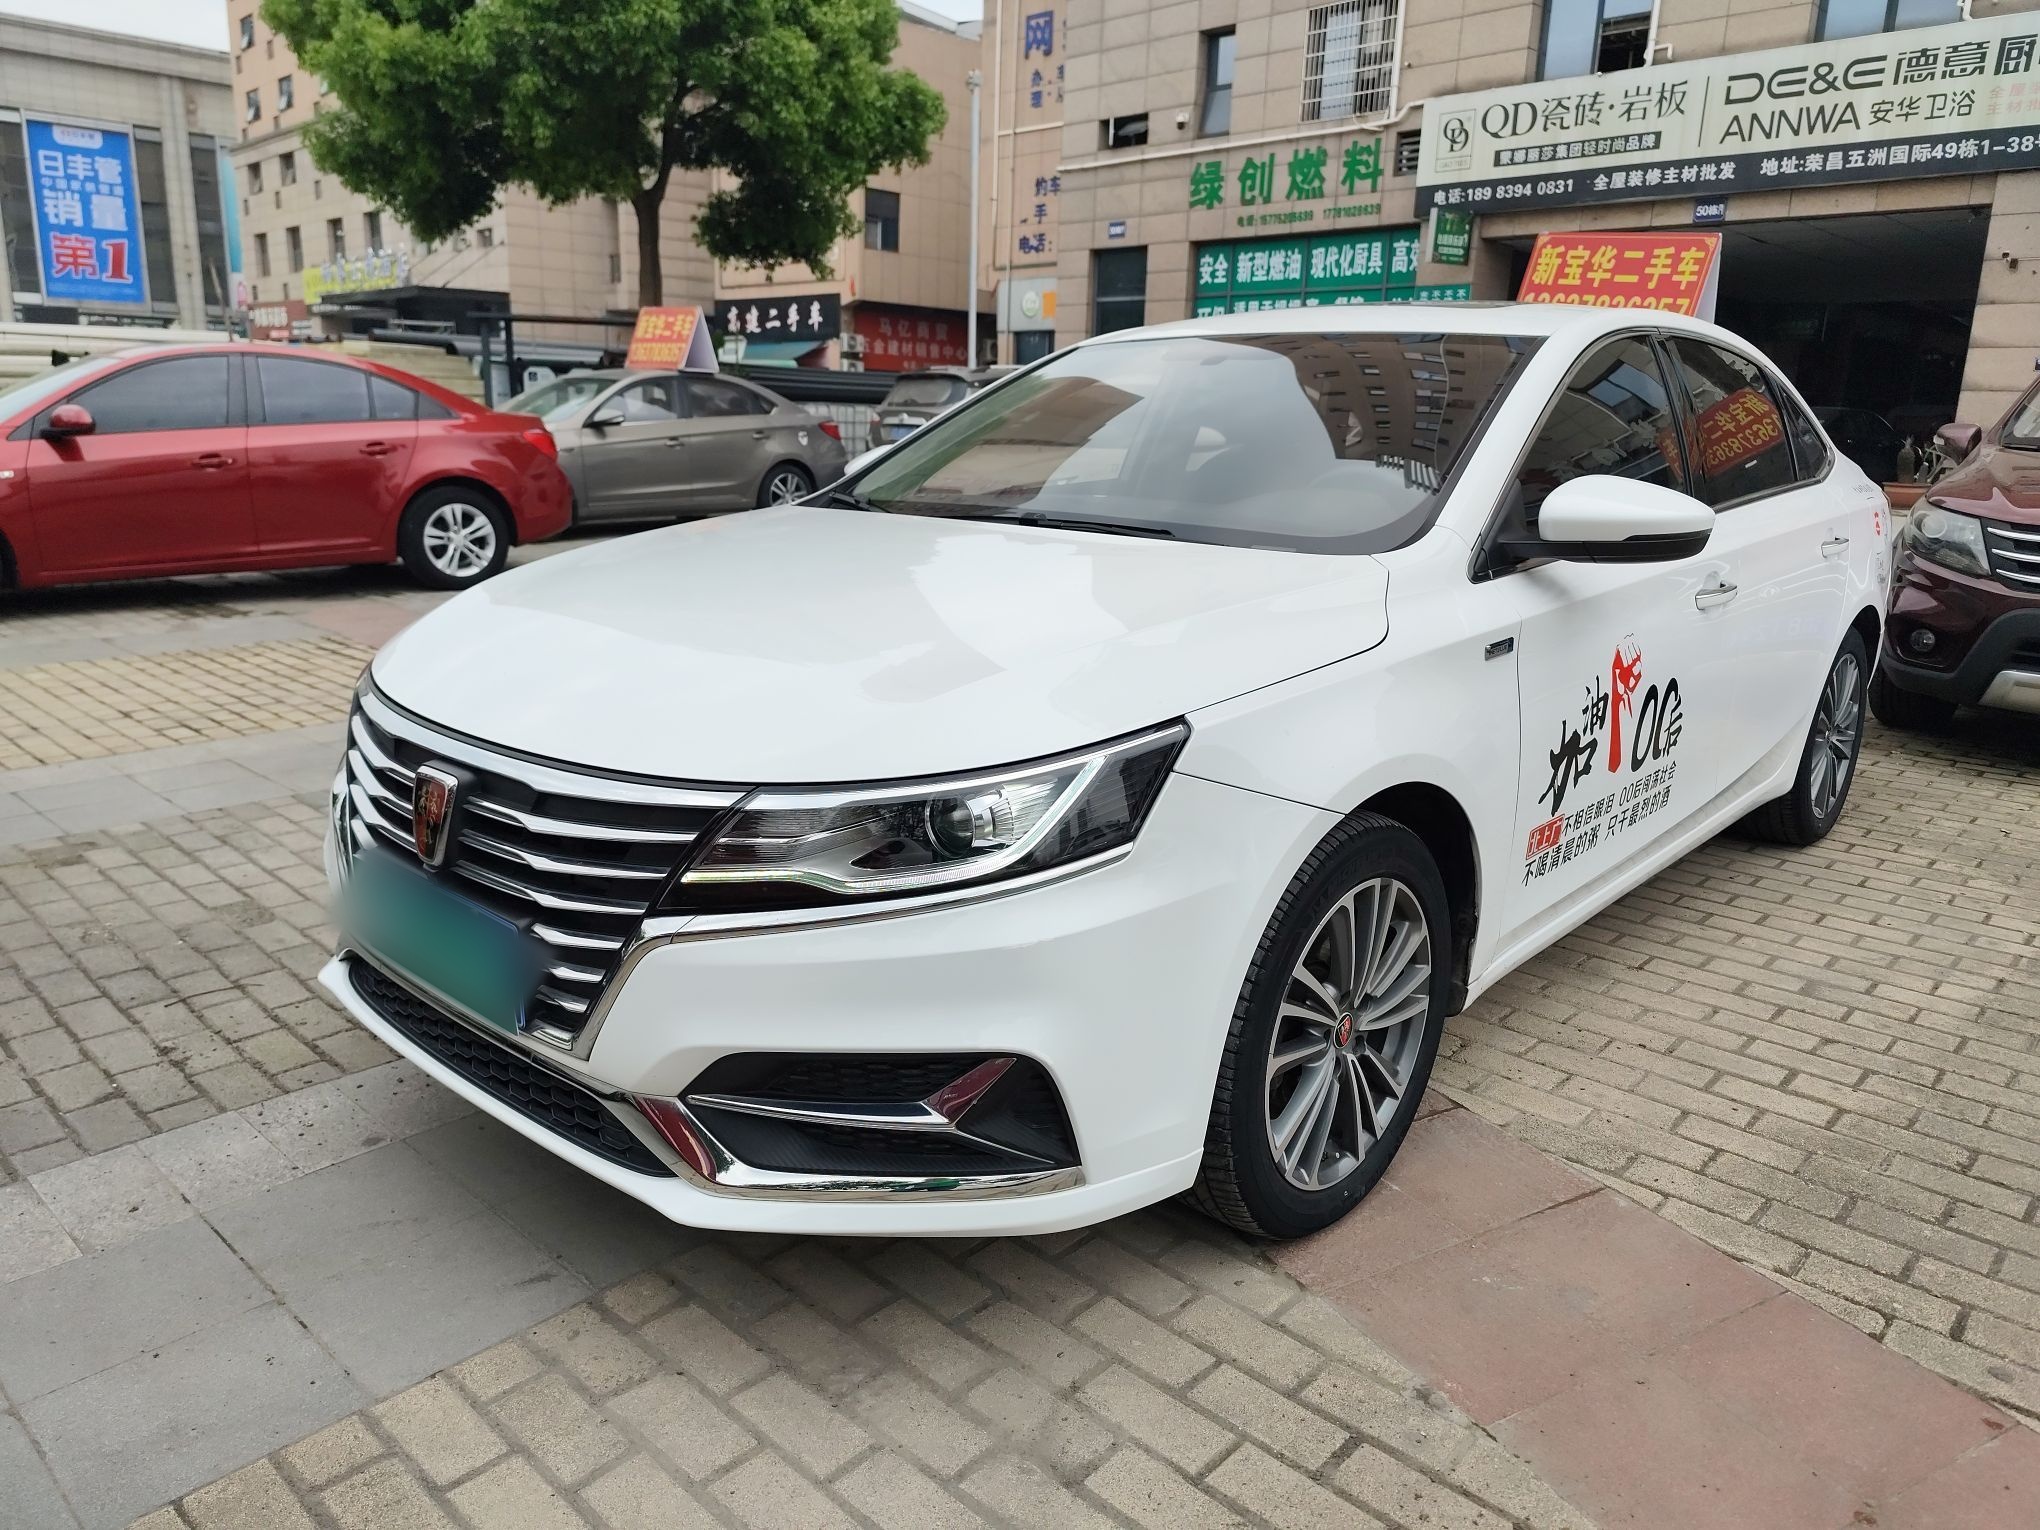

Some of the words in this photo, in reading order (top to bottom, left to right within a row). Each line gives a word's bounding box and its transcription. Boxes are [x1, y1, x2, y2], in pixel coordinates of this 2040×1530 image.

[1724, 55, 1888, 105] DE&E
[1893, 33, 2040, 86] 德意厨
[1719, 101, 1861, 144] ANNWA
[1869, 89, 1976, 126] 安华卫浴
[1189, 138, 1384, 210] 绿创燃料
[1496, 182, 1532, 199] 8394
[1537, 179, 1574, 194] 0831
[1593, 162, 1736, 191] 全屋装修主材批发
[42, 188, 128, 231] 销量
[1199, 253, 1228, 285] 安全
[1236, 249, 1302, 283] 新型燃油
[1311, 242, 1382, 279] 现代化厨具
[1532, 244, 1704, 290] 新宝华二手车
[1521, 823, 1601, 887] 不喝清晨的粥
[1604, 785, 1672, 841] 只干最烈的酒
